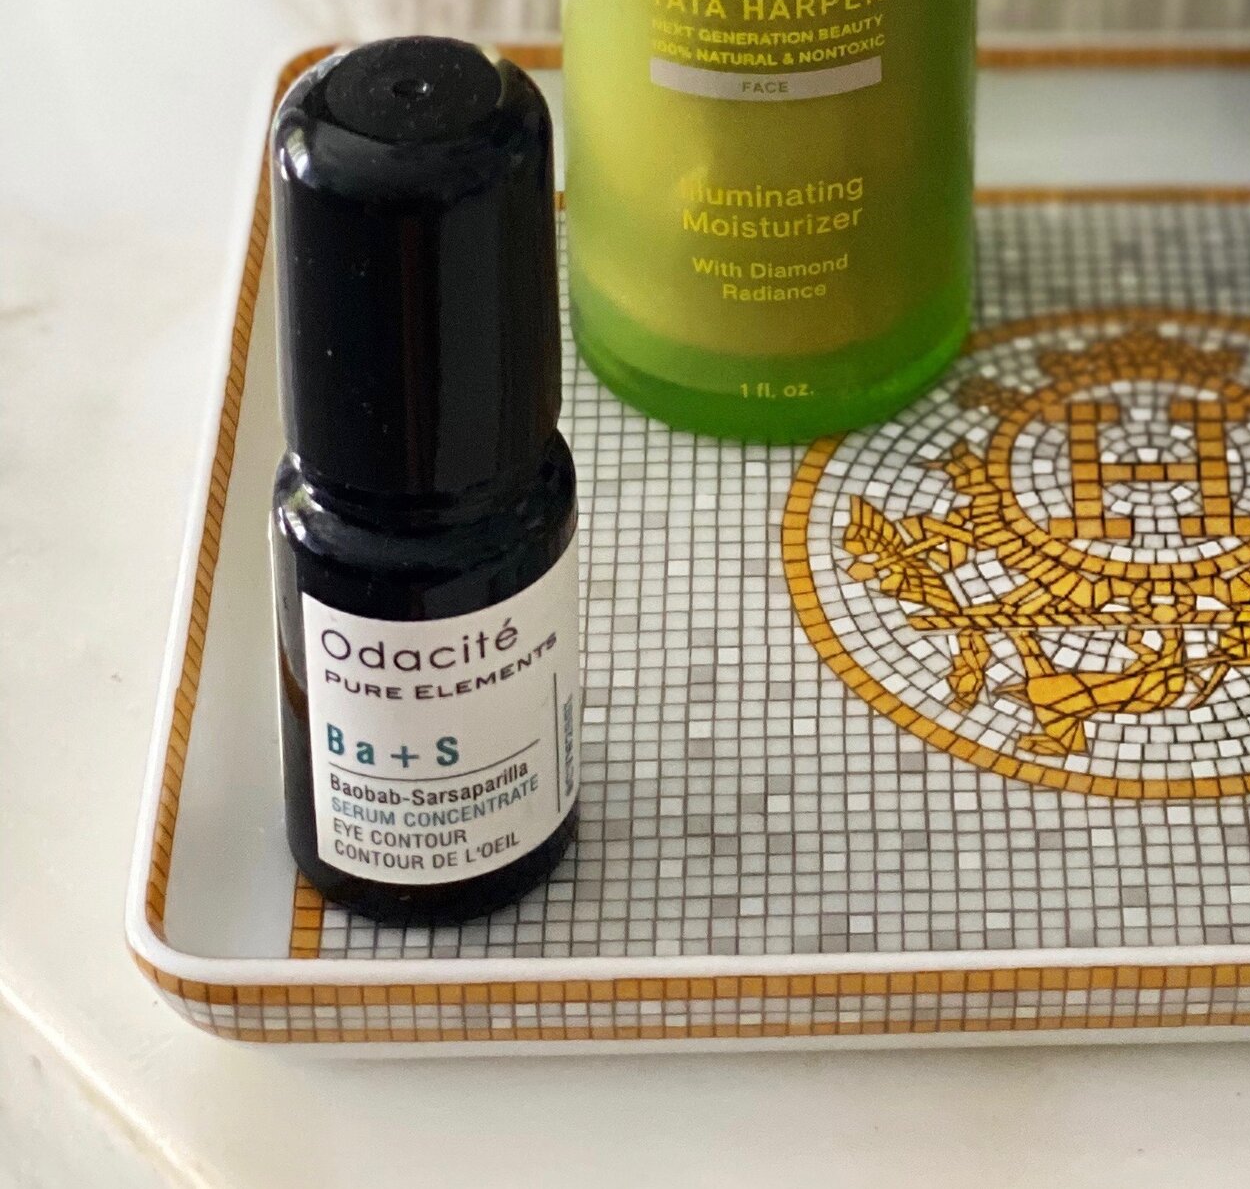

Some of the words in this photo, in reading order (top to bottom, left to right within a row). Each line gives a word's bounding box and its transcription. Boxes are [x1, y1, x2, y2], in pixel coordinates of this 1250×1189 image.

[652, 19, 695, 39] NEXT
[698, 27, 814, 46] GENERATION
[818, 14, 883, 41] BEAUTY
[696, 48, 778, 67] NATURAL
[783, 53, 795, 66] &
[799, 34, 886, 64] NONTOXIC
[741, 80, 789, 95] FACE
[682, 207, 863, 240] Moisturizer
[692, 257, 742, 279] With
[750, 253, 848, 280] Diamond
[722, 282, 826, 302] Radiance
[740, 382, 749, 399] 1
[783, 382, 815, 399] oz.
[321, 617, 519, 673] Odacité
[325, 668, 403, 700] PURE
[415, 631, 558, 700] ELEMENTS
[330, 761, 529, 807] Baobab-Sarsaparilla
[331, 796, 396, 827] SERUM
[404, 774, 539, 828] CONCENTRATE
[334, 817, 363, 843] EYE
[371, 829, 467, 849] CONTOUR
[335, 839, 425, 871] CONTOUR
[433, 850, 458, 867] DE
[465, 831, 521, 862] L'OEIL
